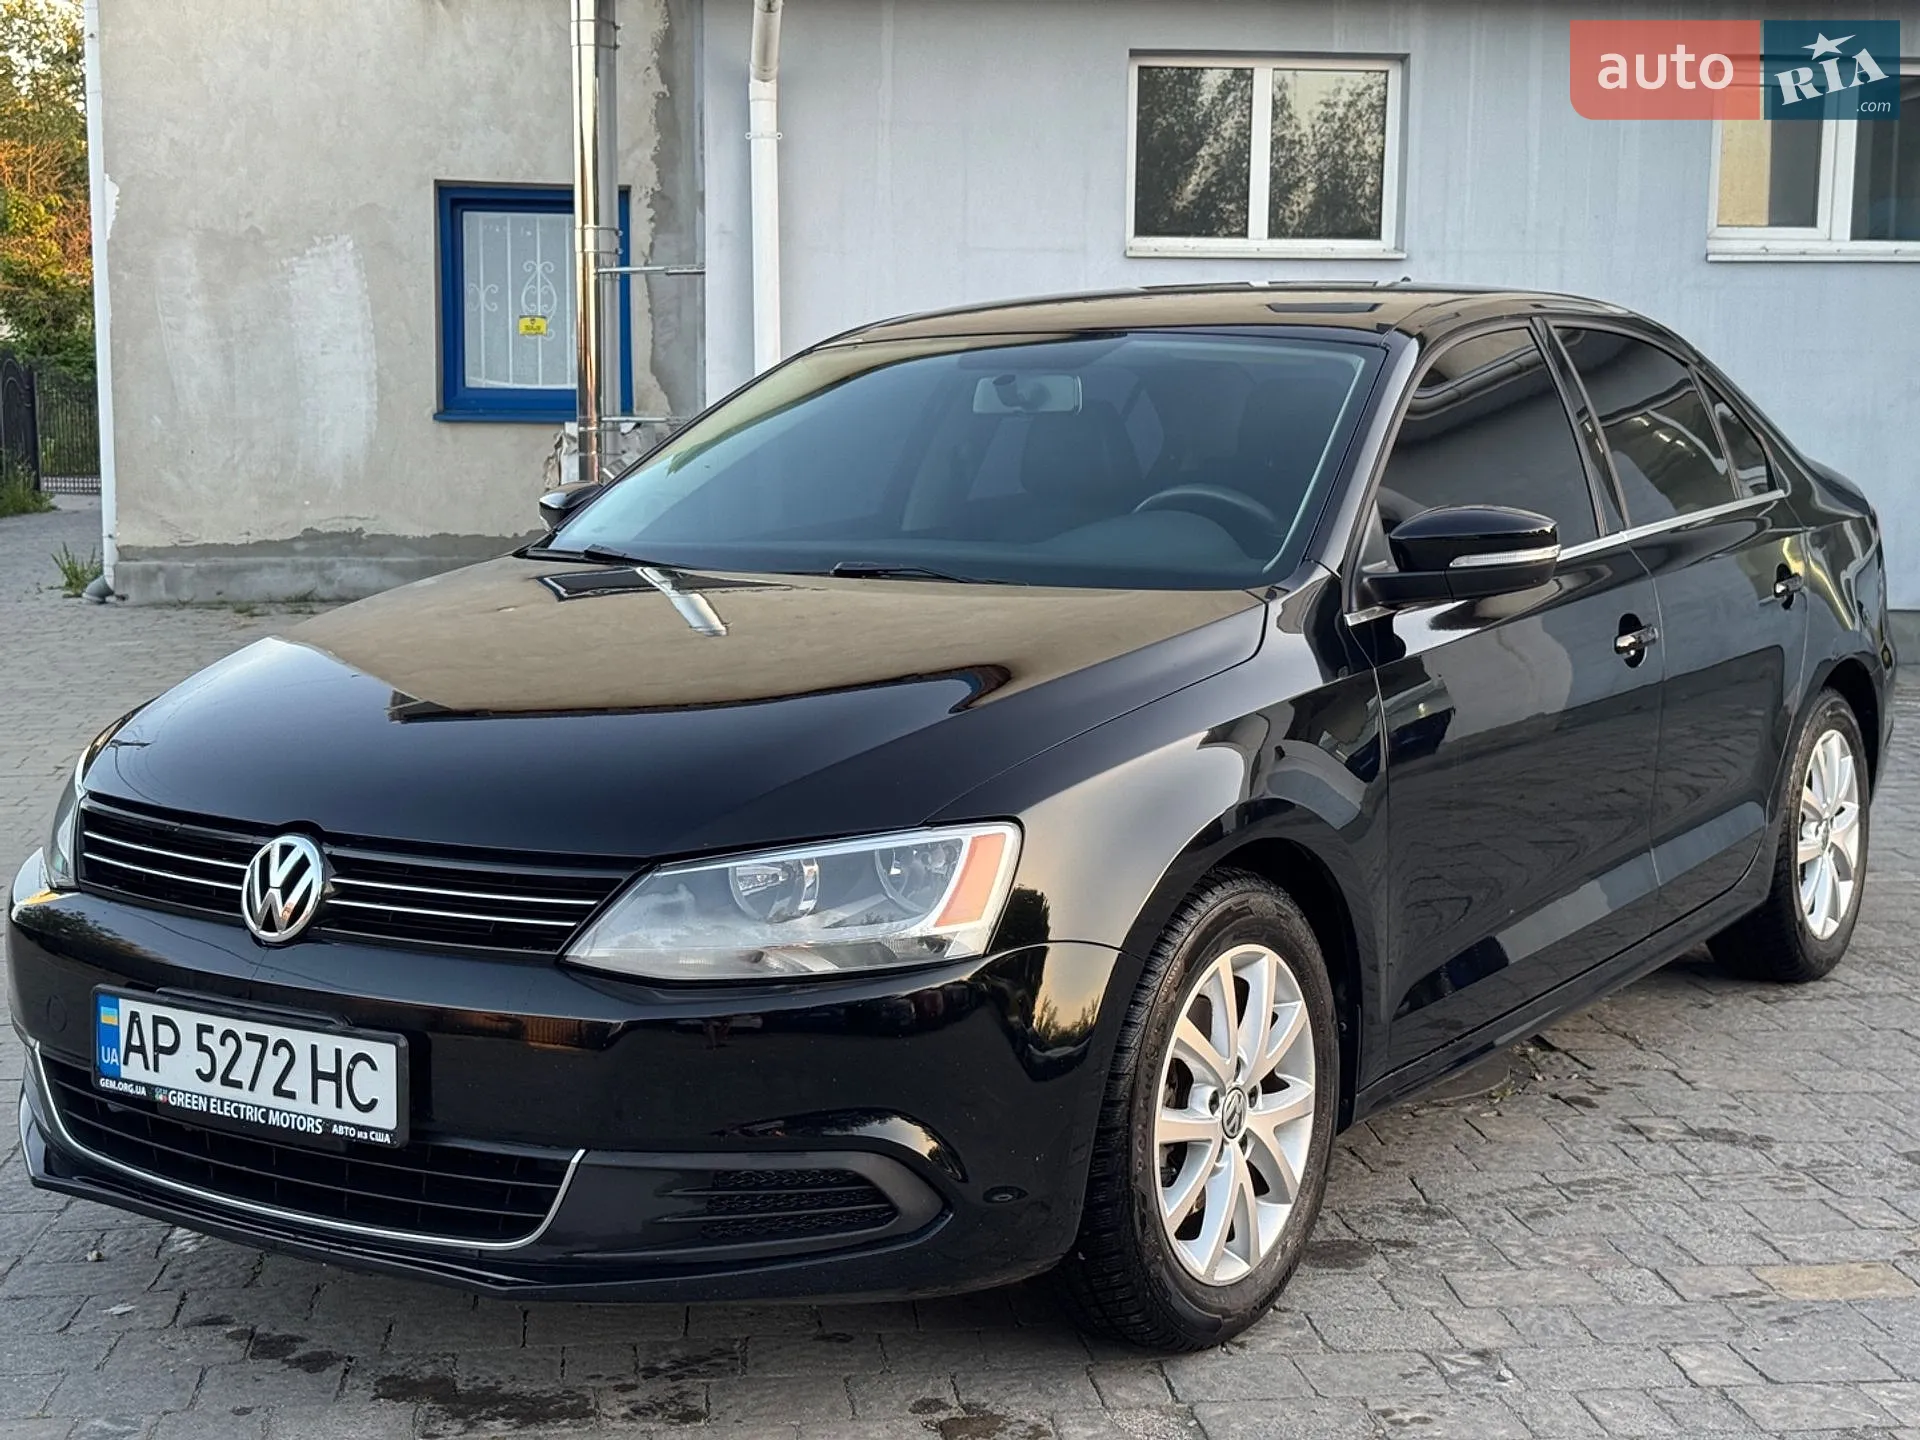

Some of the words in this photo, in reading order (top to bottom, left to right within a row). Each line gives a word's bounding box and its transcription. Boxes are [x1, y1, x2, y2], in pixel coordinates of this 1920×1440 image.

[101, 1046, 119, 1066] UA
[123, 1010, 181, 1073] AP
[195, 1023, 297, 1101] 5272
[310, 1043, 378, 1113] HC
[100, 1078, 147, 1096] GEM.ORG.UA
[168, 1090, 207, 1112] GREEN
[210, 1098, 266, 1124] ELECTRIC
[268, 1109, 323, 1135] MOTORS
[331, 1124, 356, 1137] АВТО
[357, 1131, 368, 1140] из
[369, 1131, 391, 1144] США
